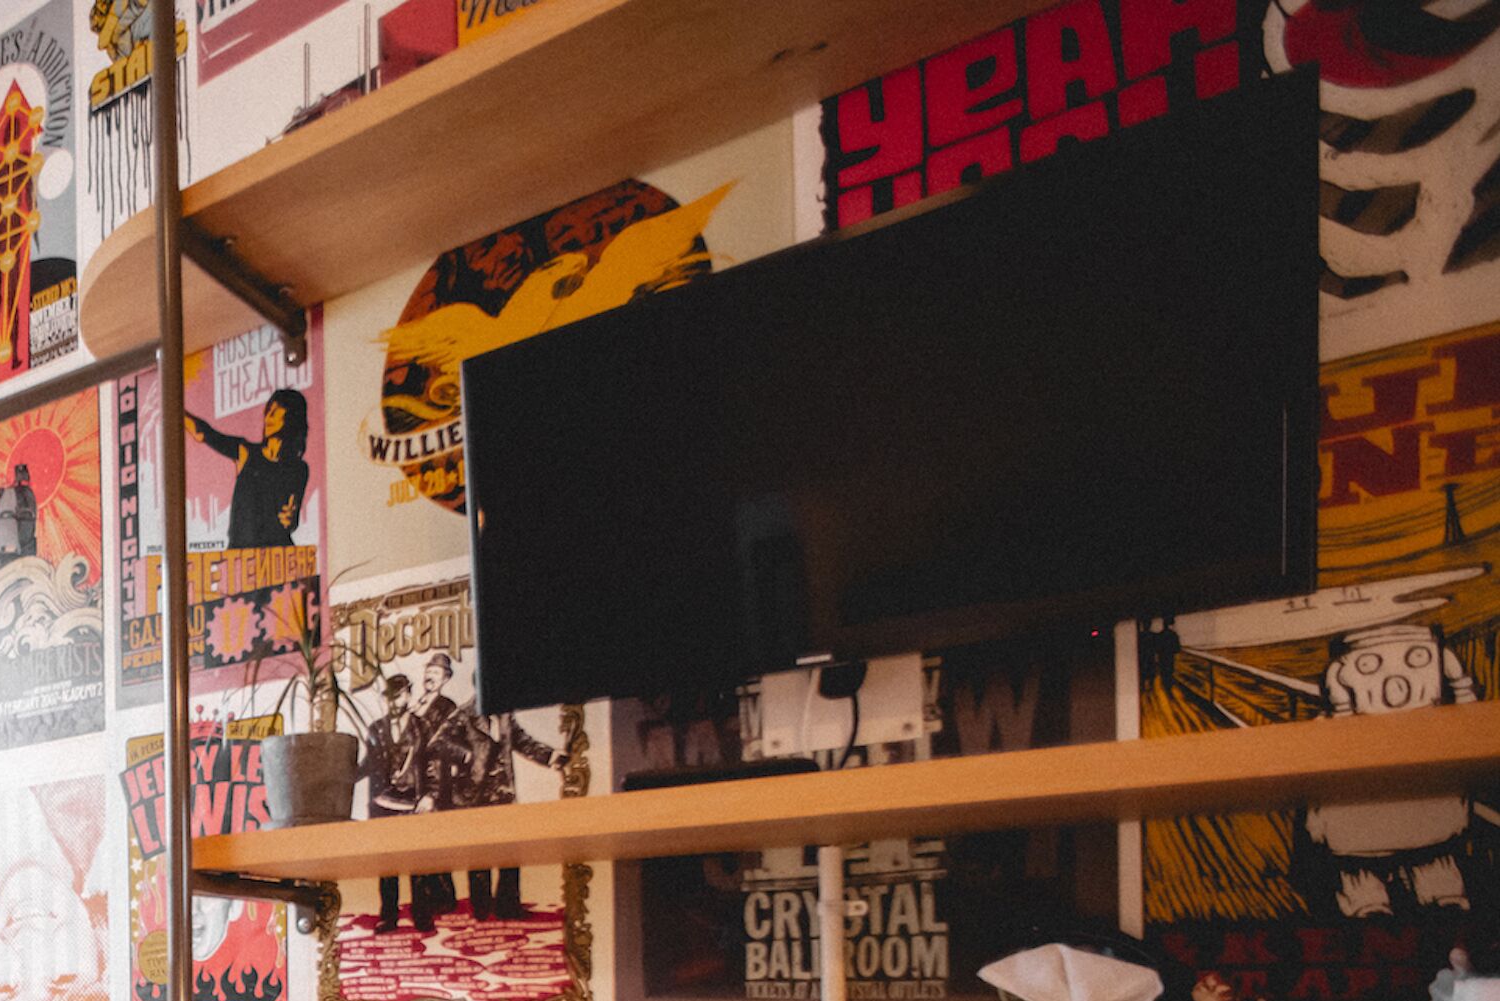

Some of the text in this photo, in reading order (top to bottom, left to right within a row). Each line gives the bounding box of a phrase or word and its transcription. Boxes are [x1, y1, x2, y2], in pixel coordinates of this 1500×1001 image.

[26, 31, 71, 148] ADDICTION
[89, 19, 188, 110] STAS
[369, 421, 463, 462] WILLIE
